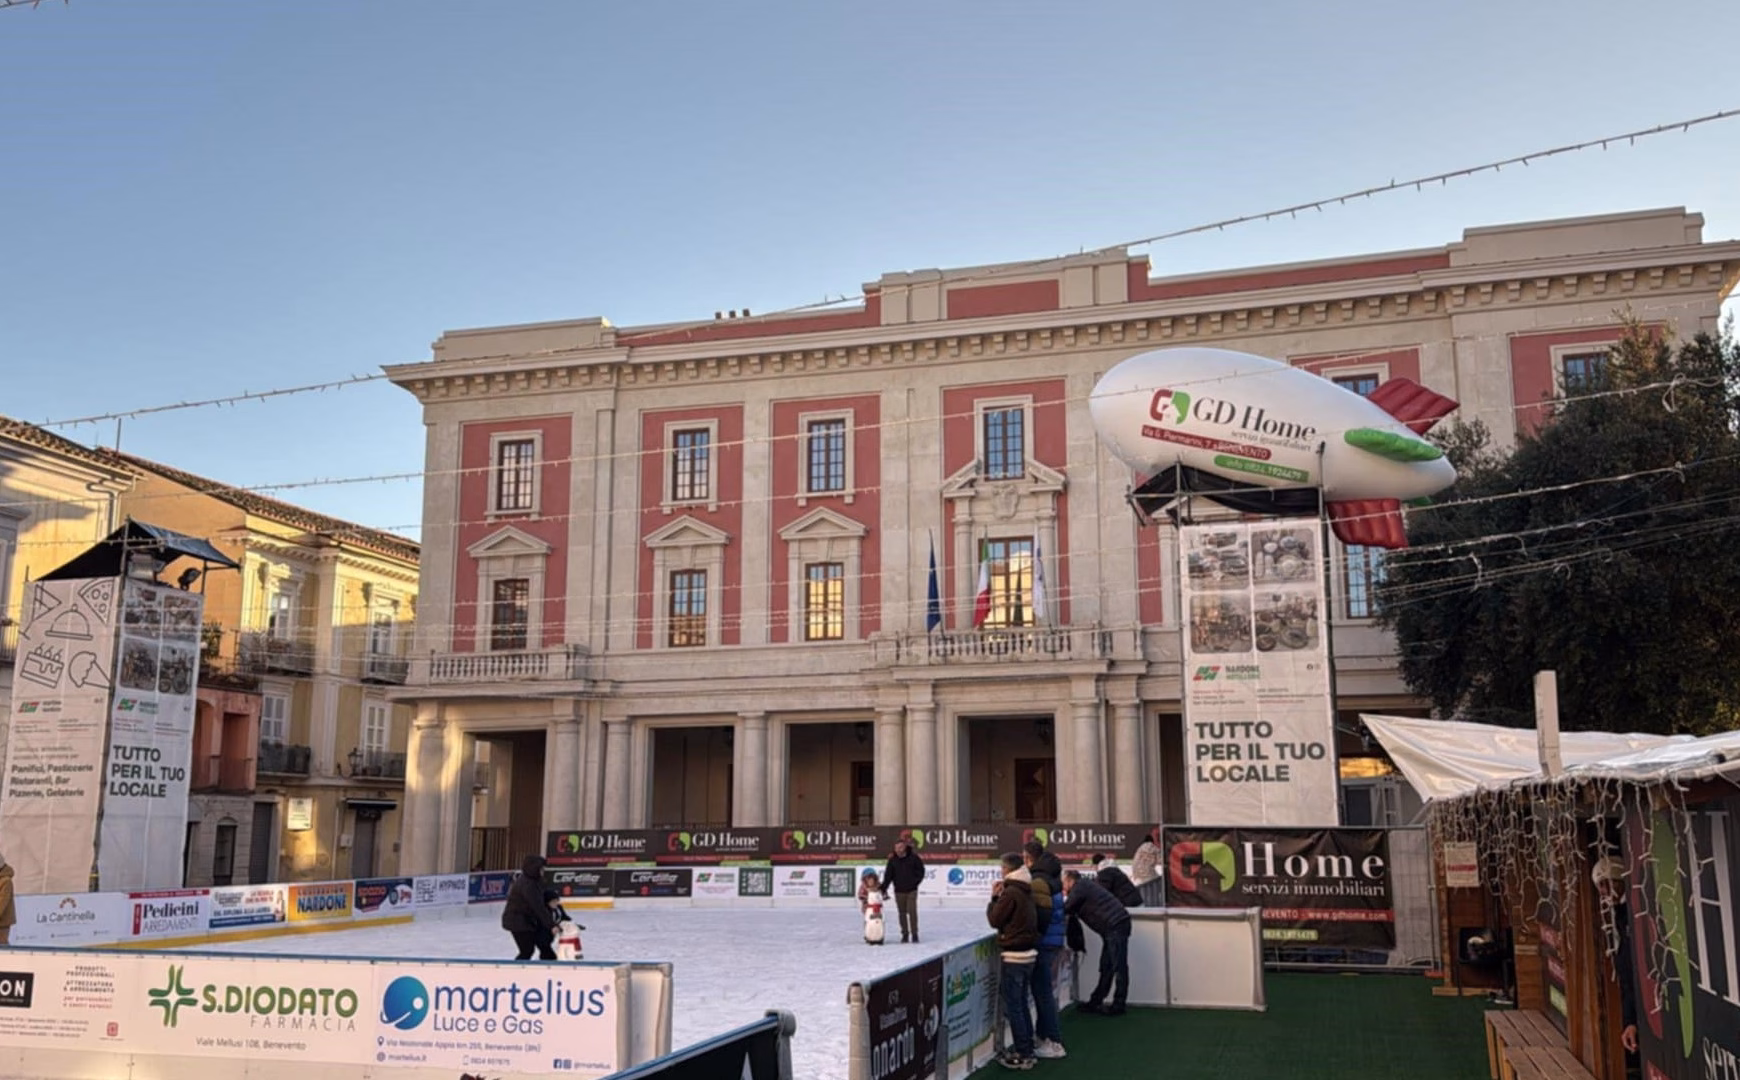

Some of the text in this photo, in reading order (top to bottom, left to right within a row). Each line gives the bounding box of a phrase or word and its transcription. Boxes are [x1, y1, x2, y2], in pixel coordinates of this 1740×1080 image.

[1193, 397, 1316, 441] GD Home
[1194, 721, 1272, 738] TUTTO
[113, 745, 162, 762] TUTTO
[1196, 742, 1325, 760] PER IL TUO
[111, 763, 186, 781] PER IL TUO
[1196, 765, 1290, 782] LOCALE
[55, 776, 71, 785] Bar
[46, 787, 84, 797] Gelaterie
[110, 782, 167, 798] LOCALE
[581, 834, 646, 849] GD Home
[692, 833, 760, 847] GD Home
[806, 831, 877, 846] GD Home
[925, 829, 998, 845] GD Home
[1049, 829, 1125, 845] GD Home
[1241, 841, 1385, 878] Home
[1242, 878, 1385, 897] servizi immobiliari
[36, 911, 95, 924] La Cantinella
[142, 901, 199, 919] Pedicini
[203, 985, 358, 1018] S.DIODATO
[435, 979, 606, 1017] martelius
[250, 1016, 356, 1032] FARMACIA
[434, 1015, 544, 1035] Luce e Gas
[196, 1037, 216, 1047] Viale
[218, 1038, 243, 1048] Mellusi
[264, 1041, 307, 1051] Benevento
[434, 1041, 455, 1050] Appia
[485, 1043, 522, 1052] Benevento
